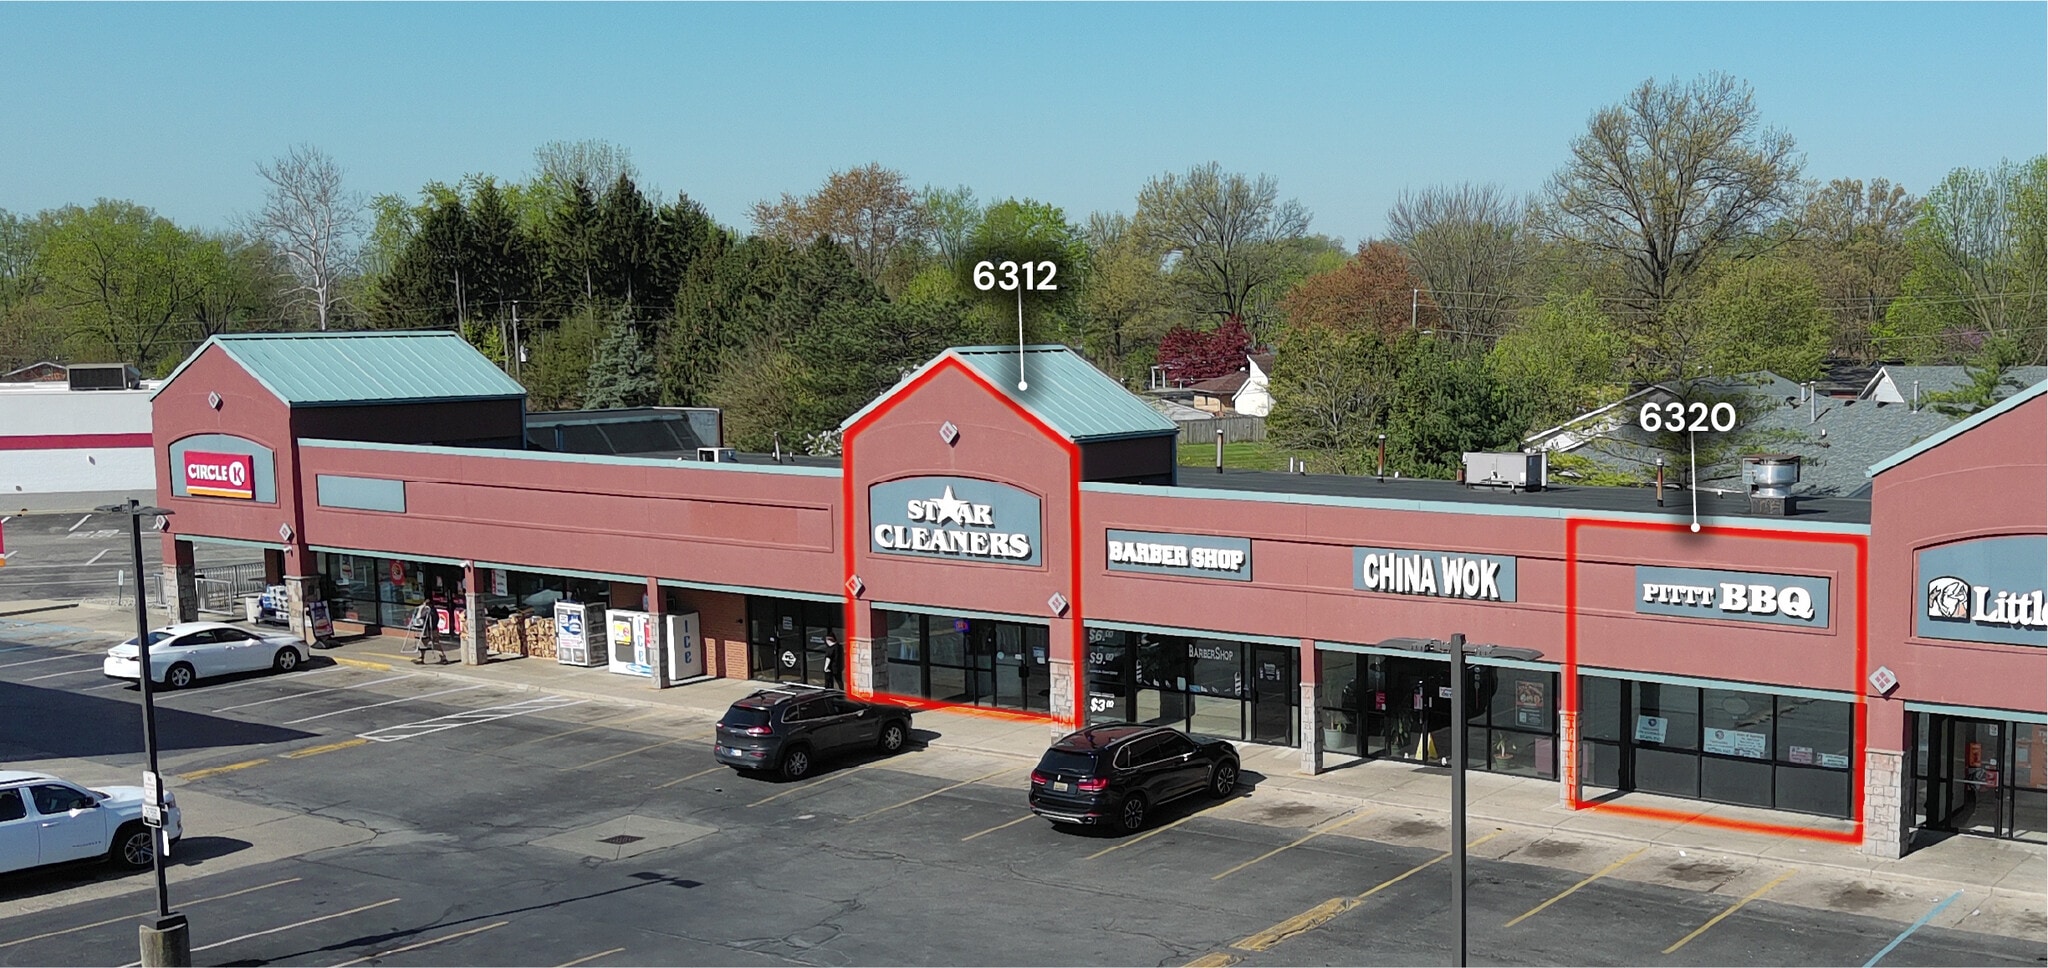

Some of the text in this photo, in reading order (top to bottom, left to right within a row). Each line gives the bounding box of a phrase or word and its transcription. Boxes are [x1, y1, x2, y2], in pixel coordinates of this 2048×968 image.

[187, 463, 244, 484] CIRCLE K
[907, 498, 994, 526] STAR
[874, 524, 1031, 559] CLEANERS
[1108, 541, 1245, 571] BARBER SHOP
[1363, 552, 1501, 599] CHINA WOK
[1642, 583, 1814, 620] PITTT BBQ
[1972, 586, 2047, 626] Littl
